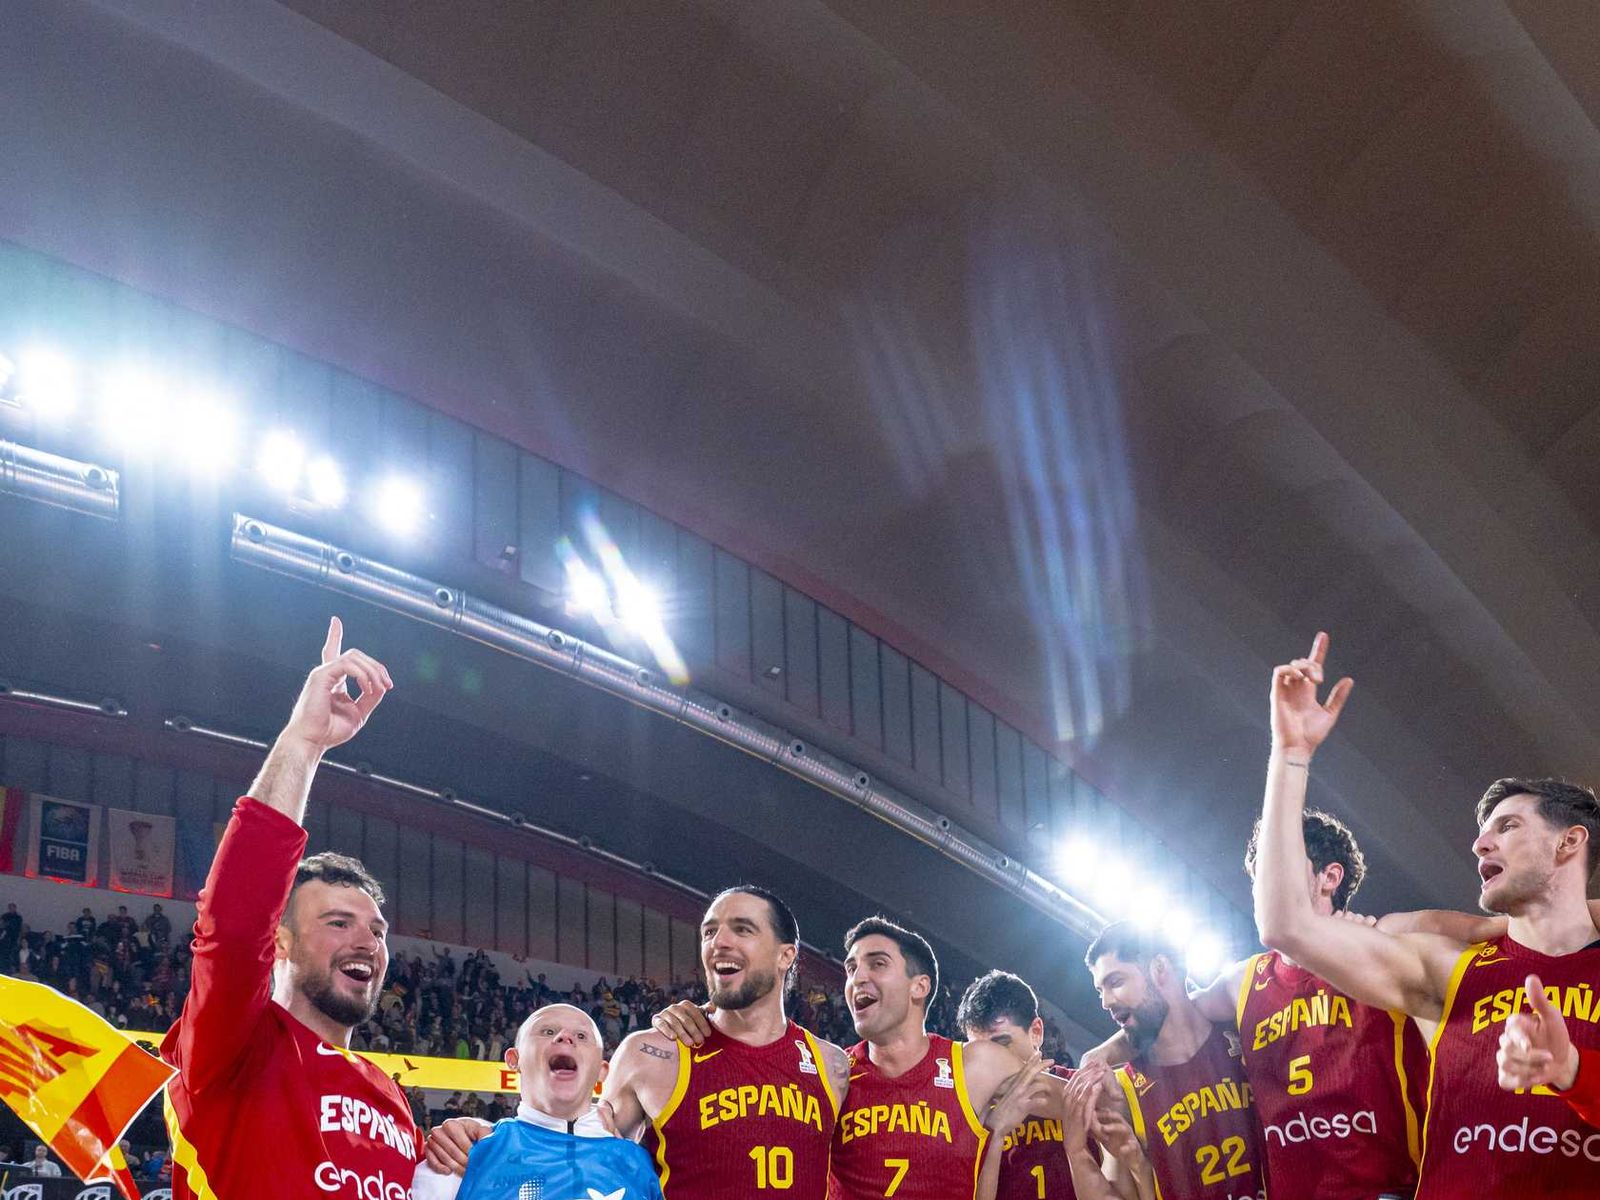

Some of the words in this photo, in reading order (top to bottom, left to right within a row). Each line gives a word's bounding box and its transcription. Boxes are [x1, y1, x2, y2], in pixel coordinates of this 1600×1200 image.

[46, 845, 80, 861] FIBA
[1252, 989, 1353, 1051] ESPAÑA
[1287, 1055, 1313, 1095] 5
[320, 1094, 416, 1162] ESPAÑA
[700, 1083, 823, 1132] ESPAÑA
[841, 1101, 952, 1144] ESPAÑA
[1157, 1078, 1253, 1147] ESPAÑA
[1264, 1111, 1377, 1147] ndesa
[749, 1145, 793, 1189] 10
[884, 1159, 909, 1197] 7
[1030, 1165, 1046, 1200] 1
[1195, 1136, 1251, 1186] 22
